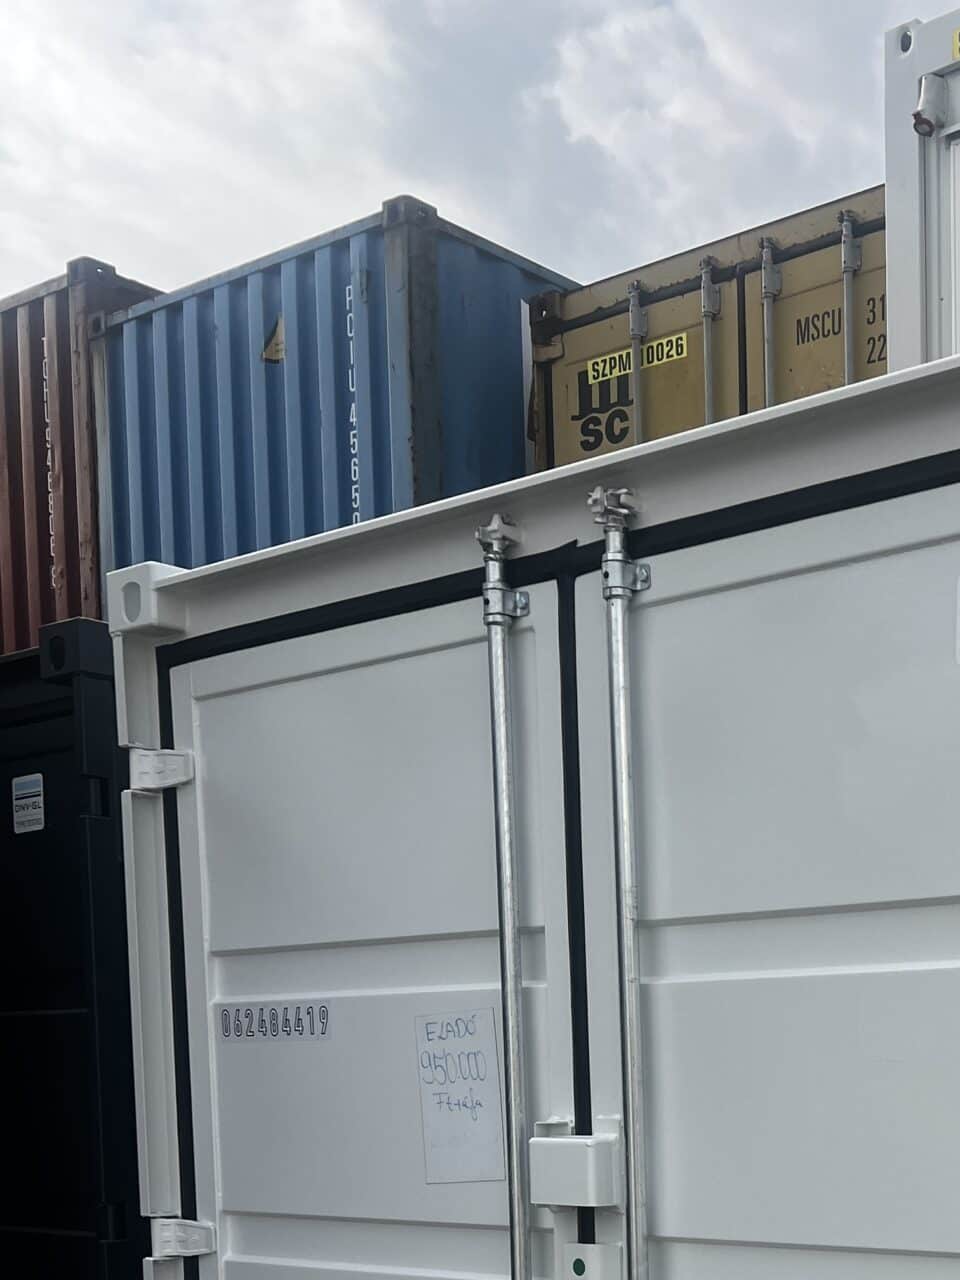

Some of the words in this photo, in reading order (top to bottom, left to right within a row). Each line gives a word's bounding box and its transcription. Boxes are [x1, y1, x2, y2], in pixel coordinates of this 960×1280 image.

[796, 307, 842, 346] MSCU
[866, 334, 887, 364] 22
[591, 351, 632, 380] SZPM
[221, 1005, 329, 1038] 062484419
